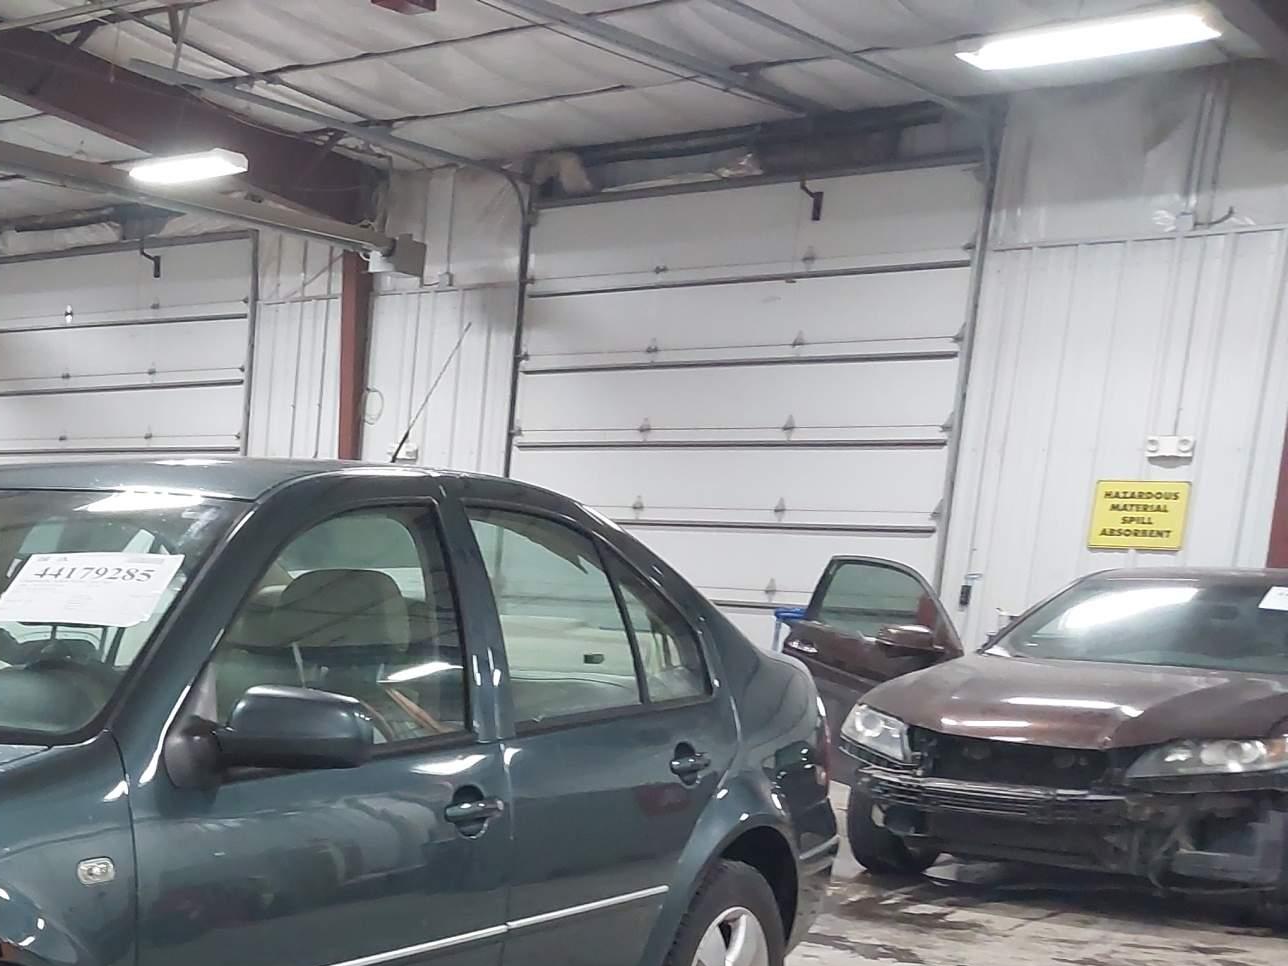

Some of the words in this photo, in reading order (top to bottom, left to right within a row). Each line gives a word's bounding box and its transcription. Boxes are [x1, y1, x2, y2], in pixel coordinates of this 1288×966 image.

[1104, 491, 1180, 500] HAZARDOUS
[1109, 504, 1169, 513] MATERIAL
[1120, 516, 1154, 525] SPILL
[1099, 528, 1172, 538] ABSORBENT
[33, 567, 156, 582] 44179285
